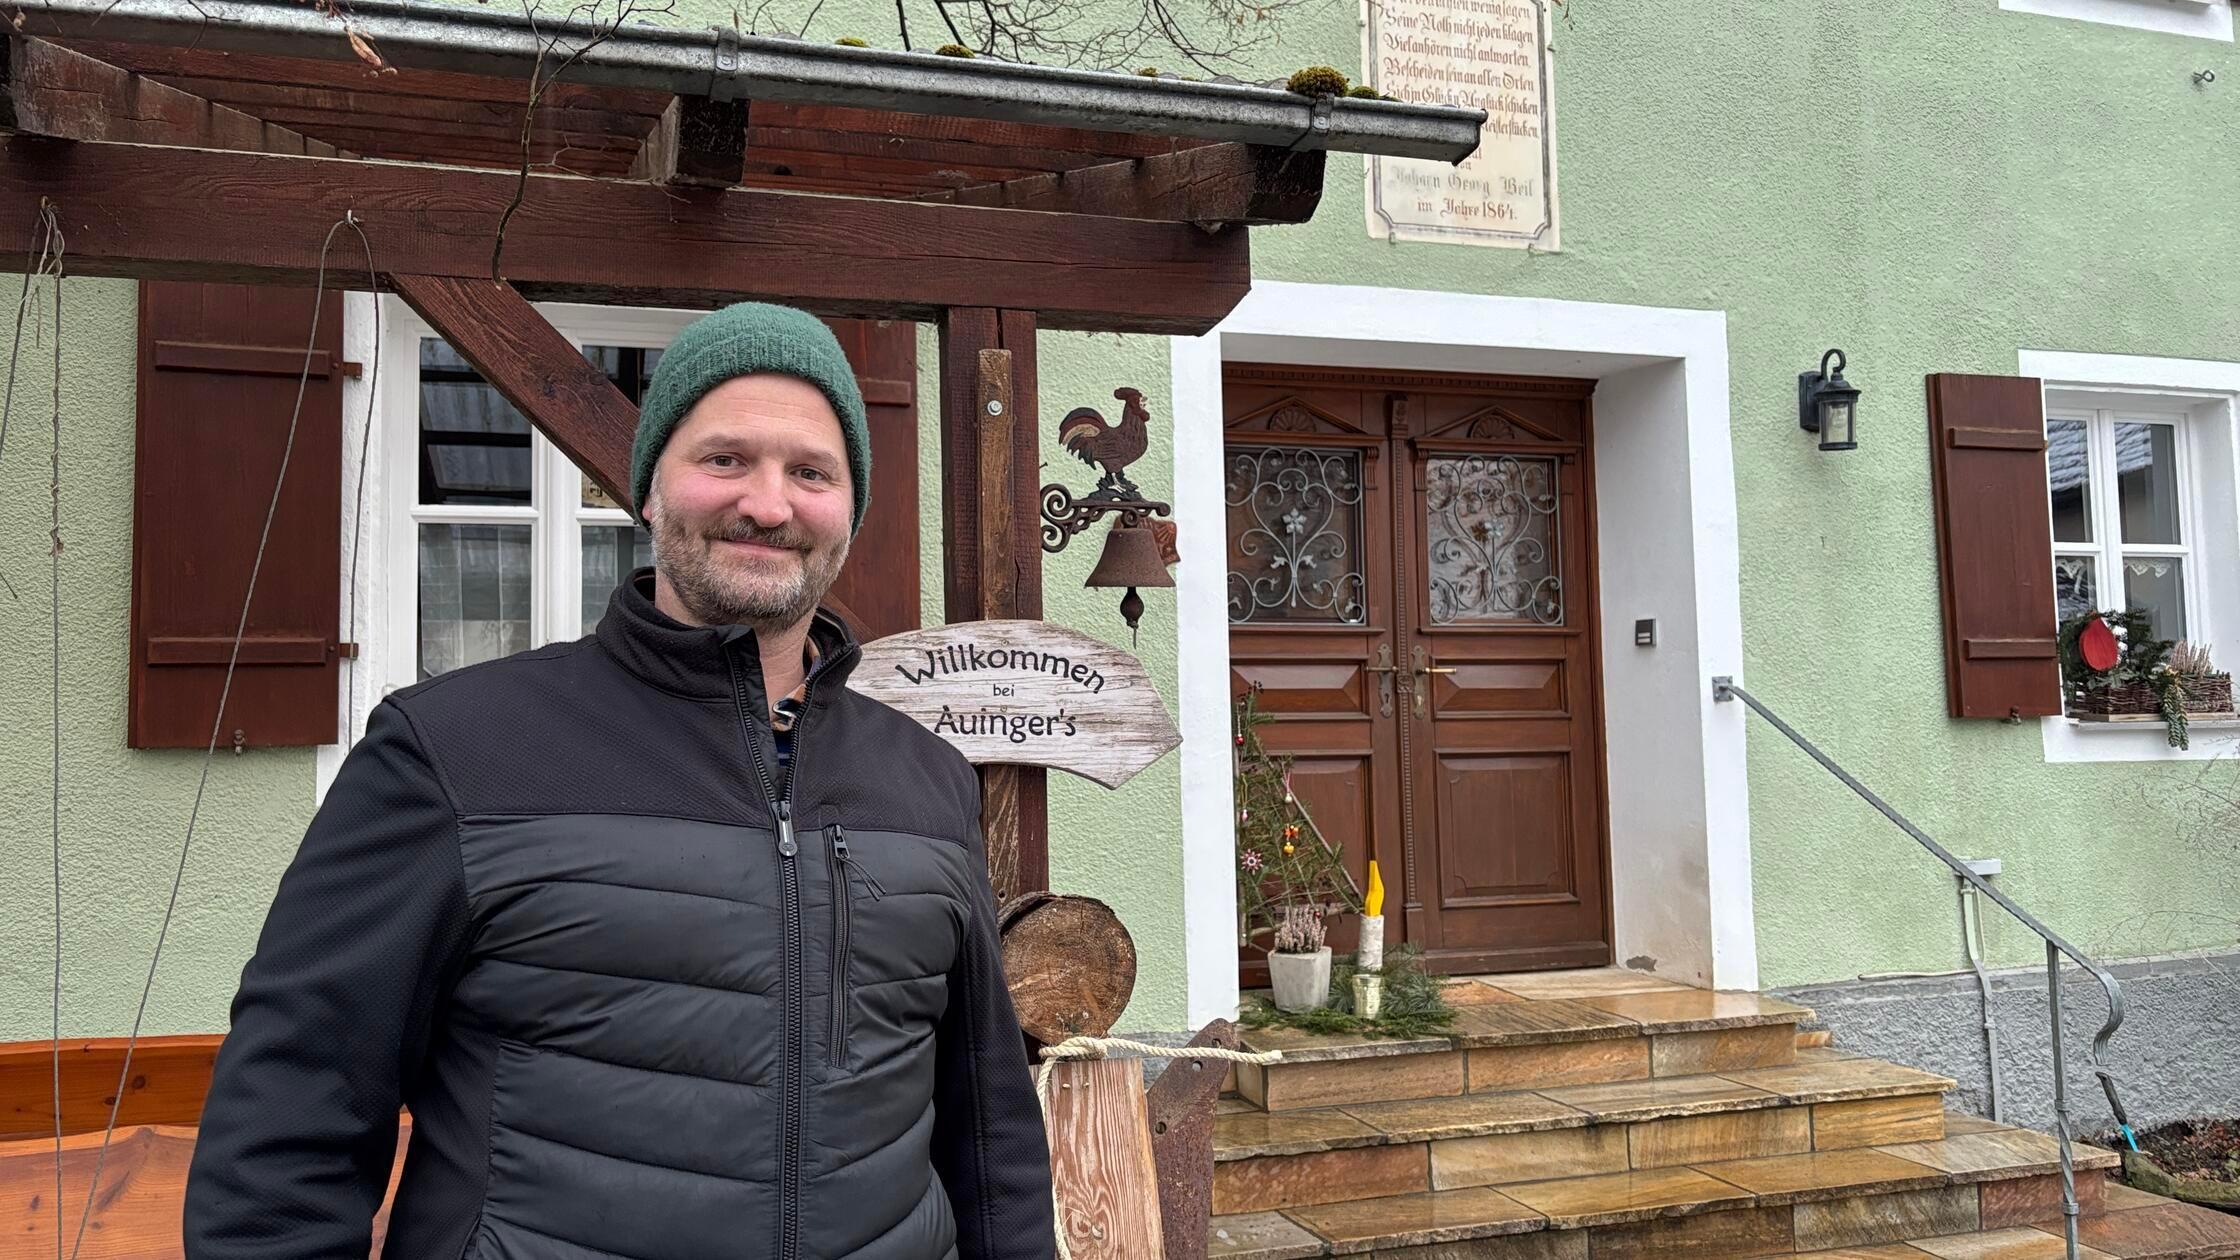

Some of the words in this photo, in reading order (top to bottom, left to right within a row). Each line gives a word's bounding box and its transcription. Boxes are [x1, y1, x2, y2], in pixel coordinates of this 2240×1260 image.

[1383, 7, 1418, 29] Seine
[1453, 18, 1476, 38] nicht
[1502, 23, 1534, 48] klagen
[1453, 42, 1477, 62] nicht
[1417, 196, 1433, 212] im
[1440, 197, 1480, 220] Jahre
[895, 643, 1105, 694] Willkommen
[993, 684, 1015, 697] bei
[934, 705, 1076, 743] Auinger's
